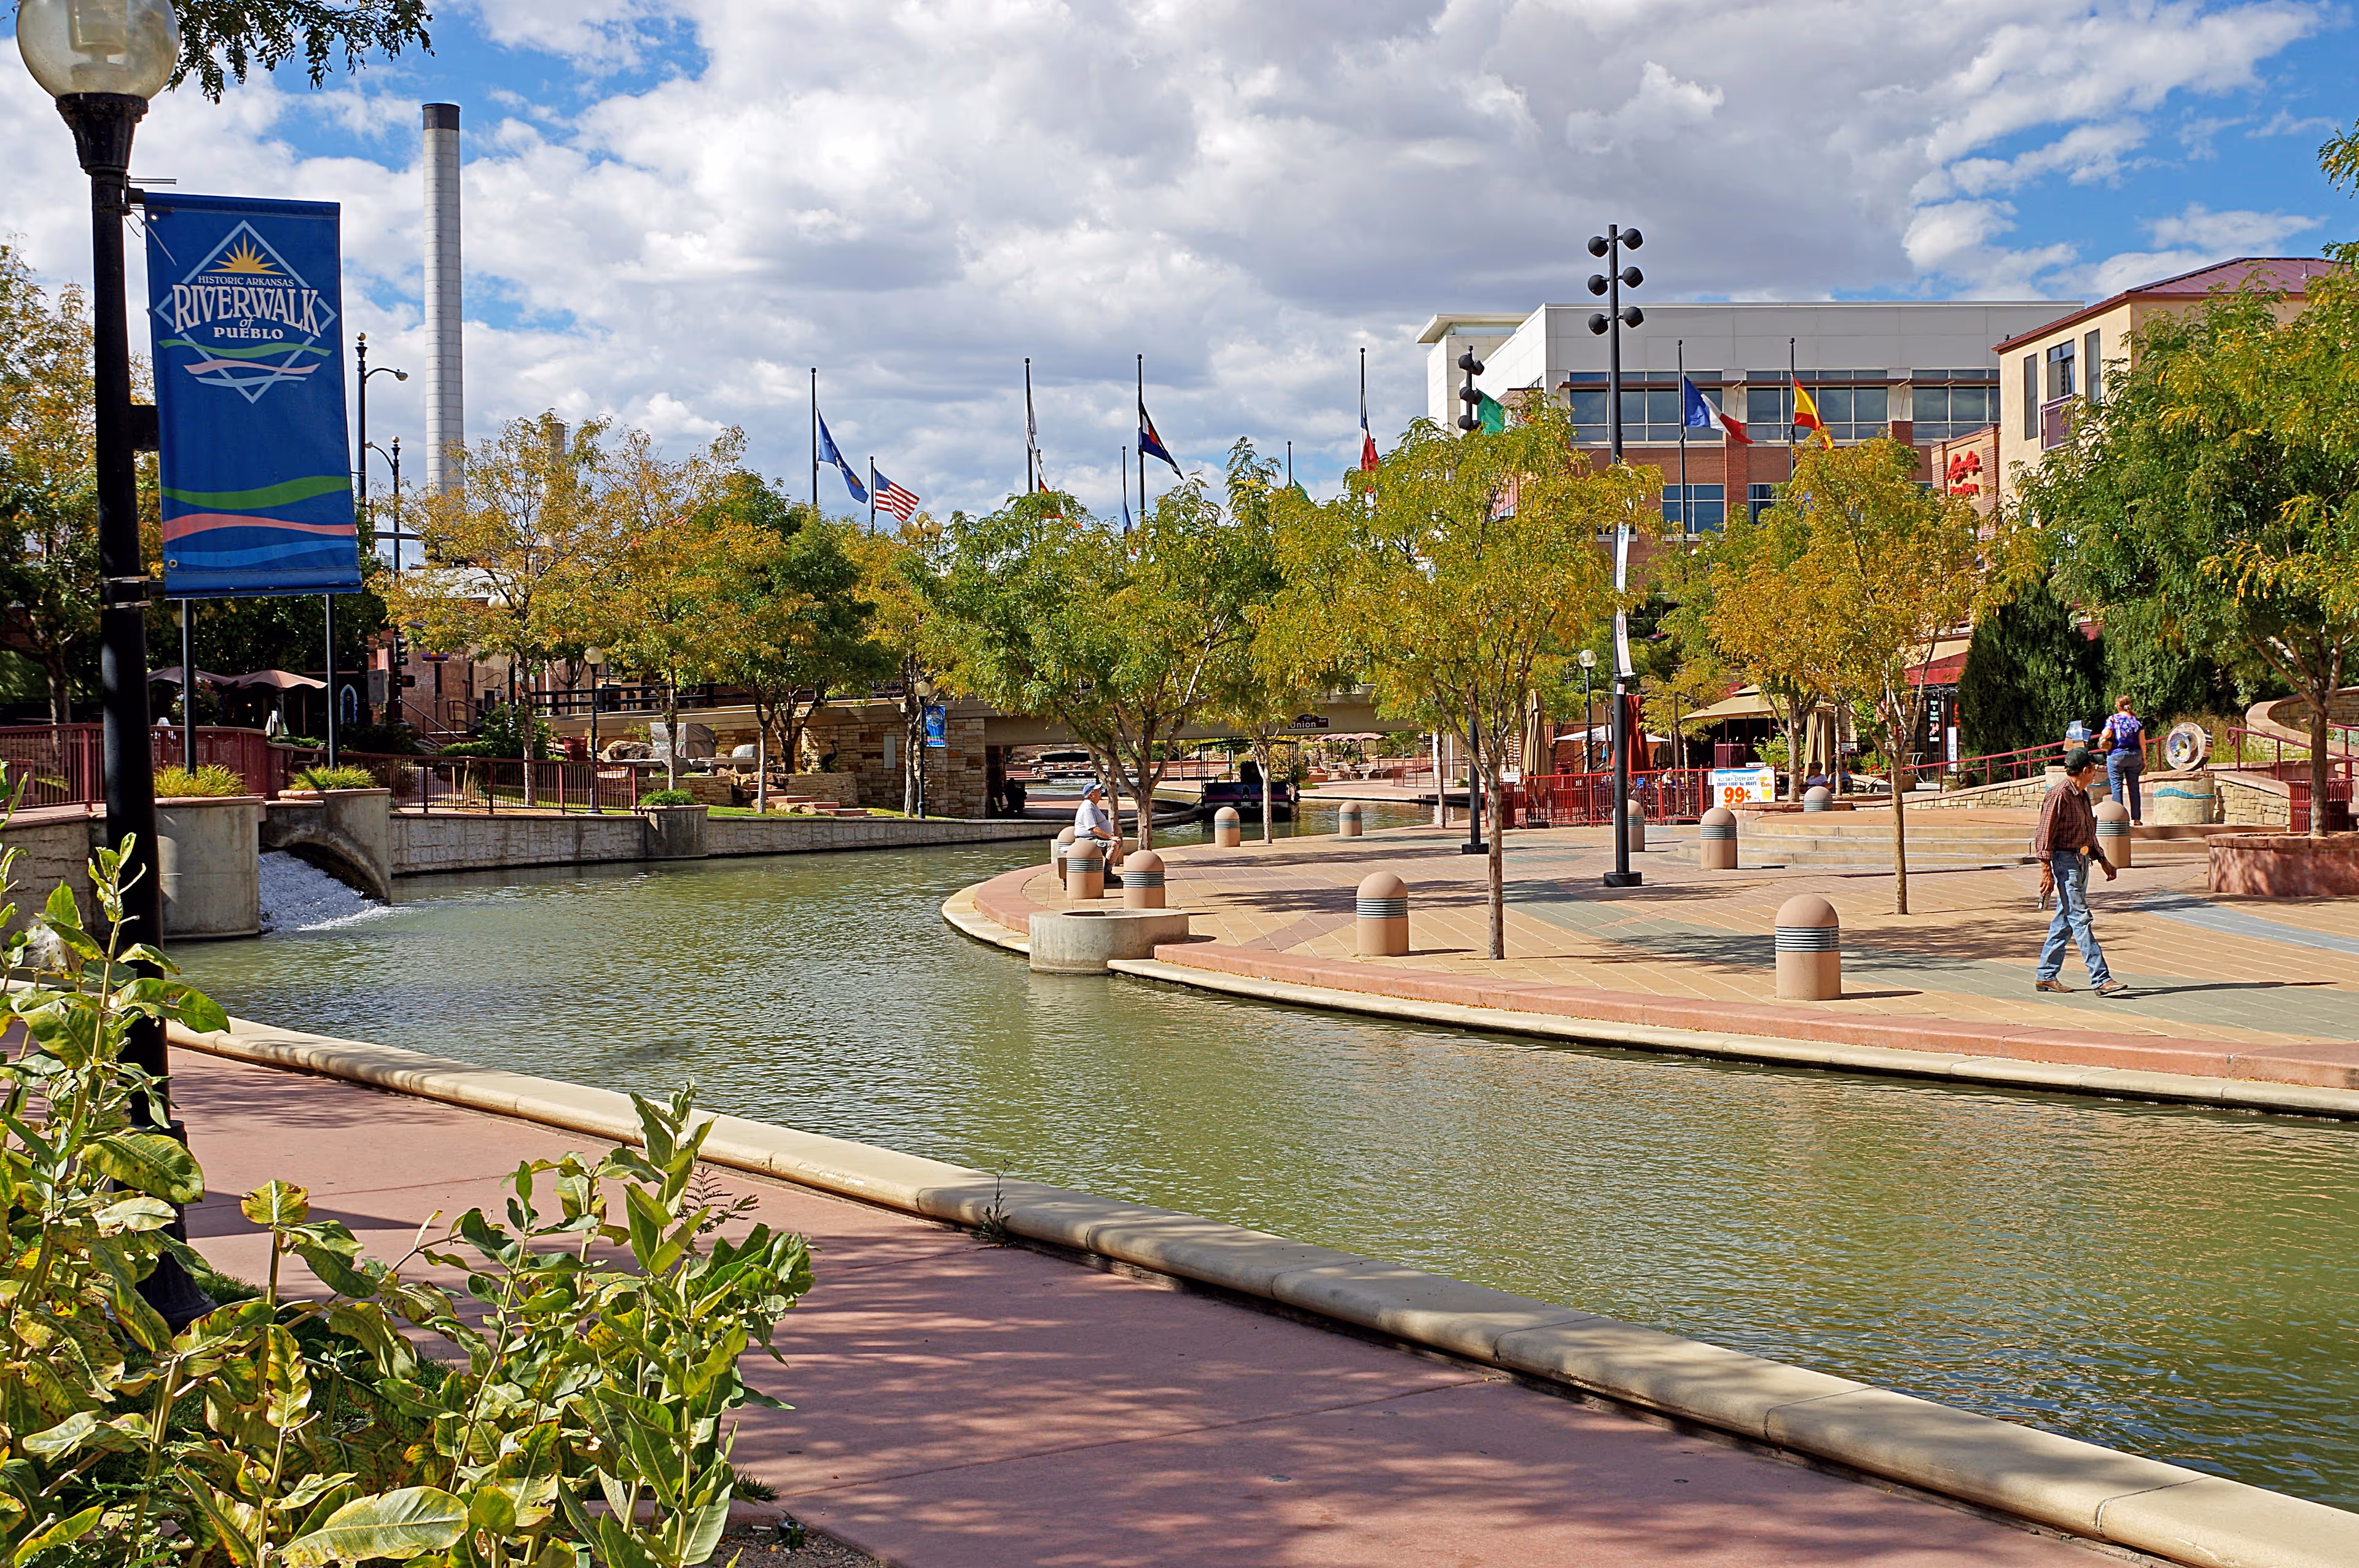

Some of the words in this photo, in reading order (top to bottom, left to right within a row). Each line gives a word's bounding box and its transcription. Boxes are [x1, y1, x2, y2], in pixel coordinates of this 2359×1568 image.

[198, 276, 244, 286] HISTORIC
[246, 278, 294, 287] ARKANSAS
[172, 284, 321, 338] RIVERWALK
[239, 314, 256, 329] of
[213, 327, 284, 339] PUEBLO
